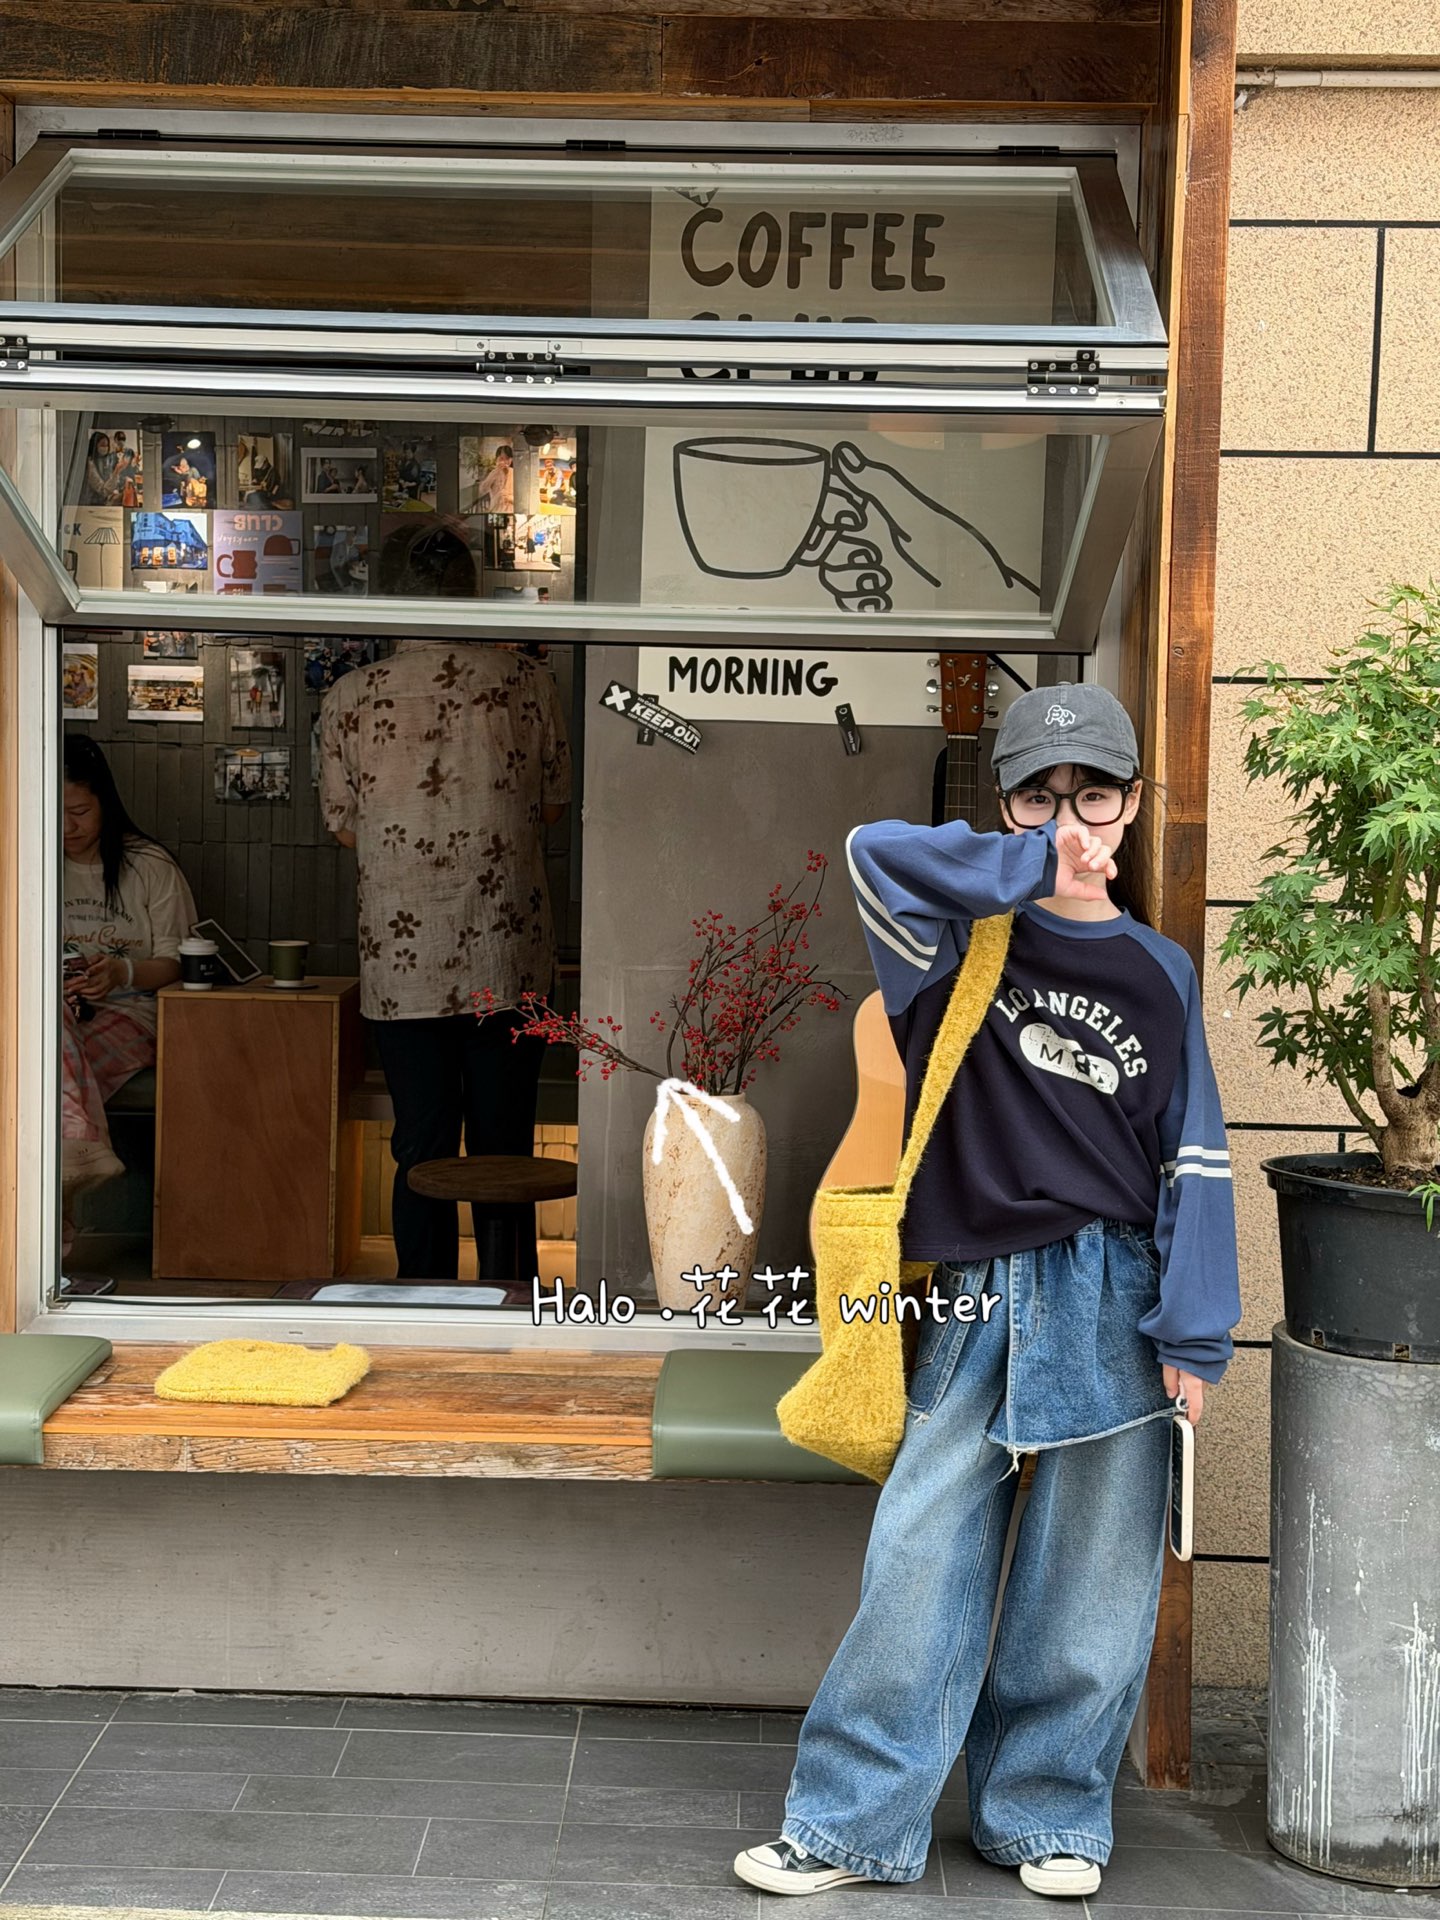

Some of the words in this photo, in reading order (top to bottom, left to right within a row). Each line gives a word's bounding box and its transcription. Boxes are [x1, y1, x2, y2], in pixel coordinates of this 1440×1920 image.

[681, 207, 946, 292] COFFEE
[668, 656, 838, 698] MORNING
[630, 702, 675, 729] KEEP
[673, 725, 701, 748] OUT
[1032, 988, 1149, 1078] ANGELES
